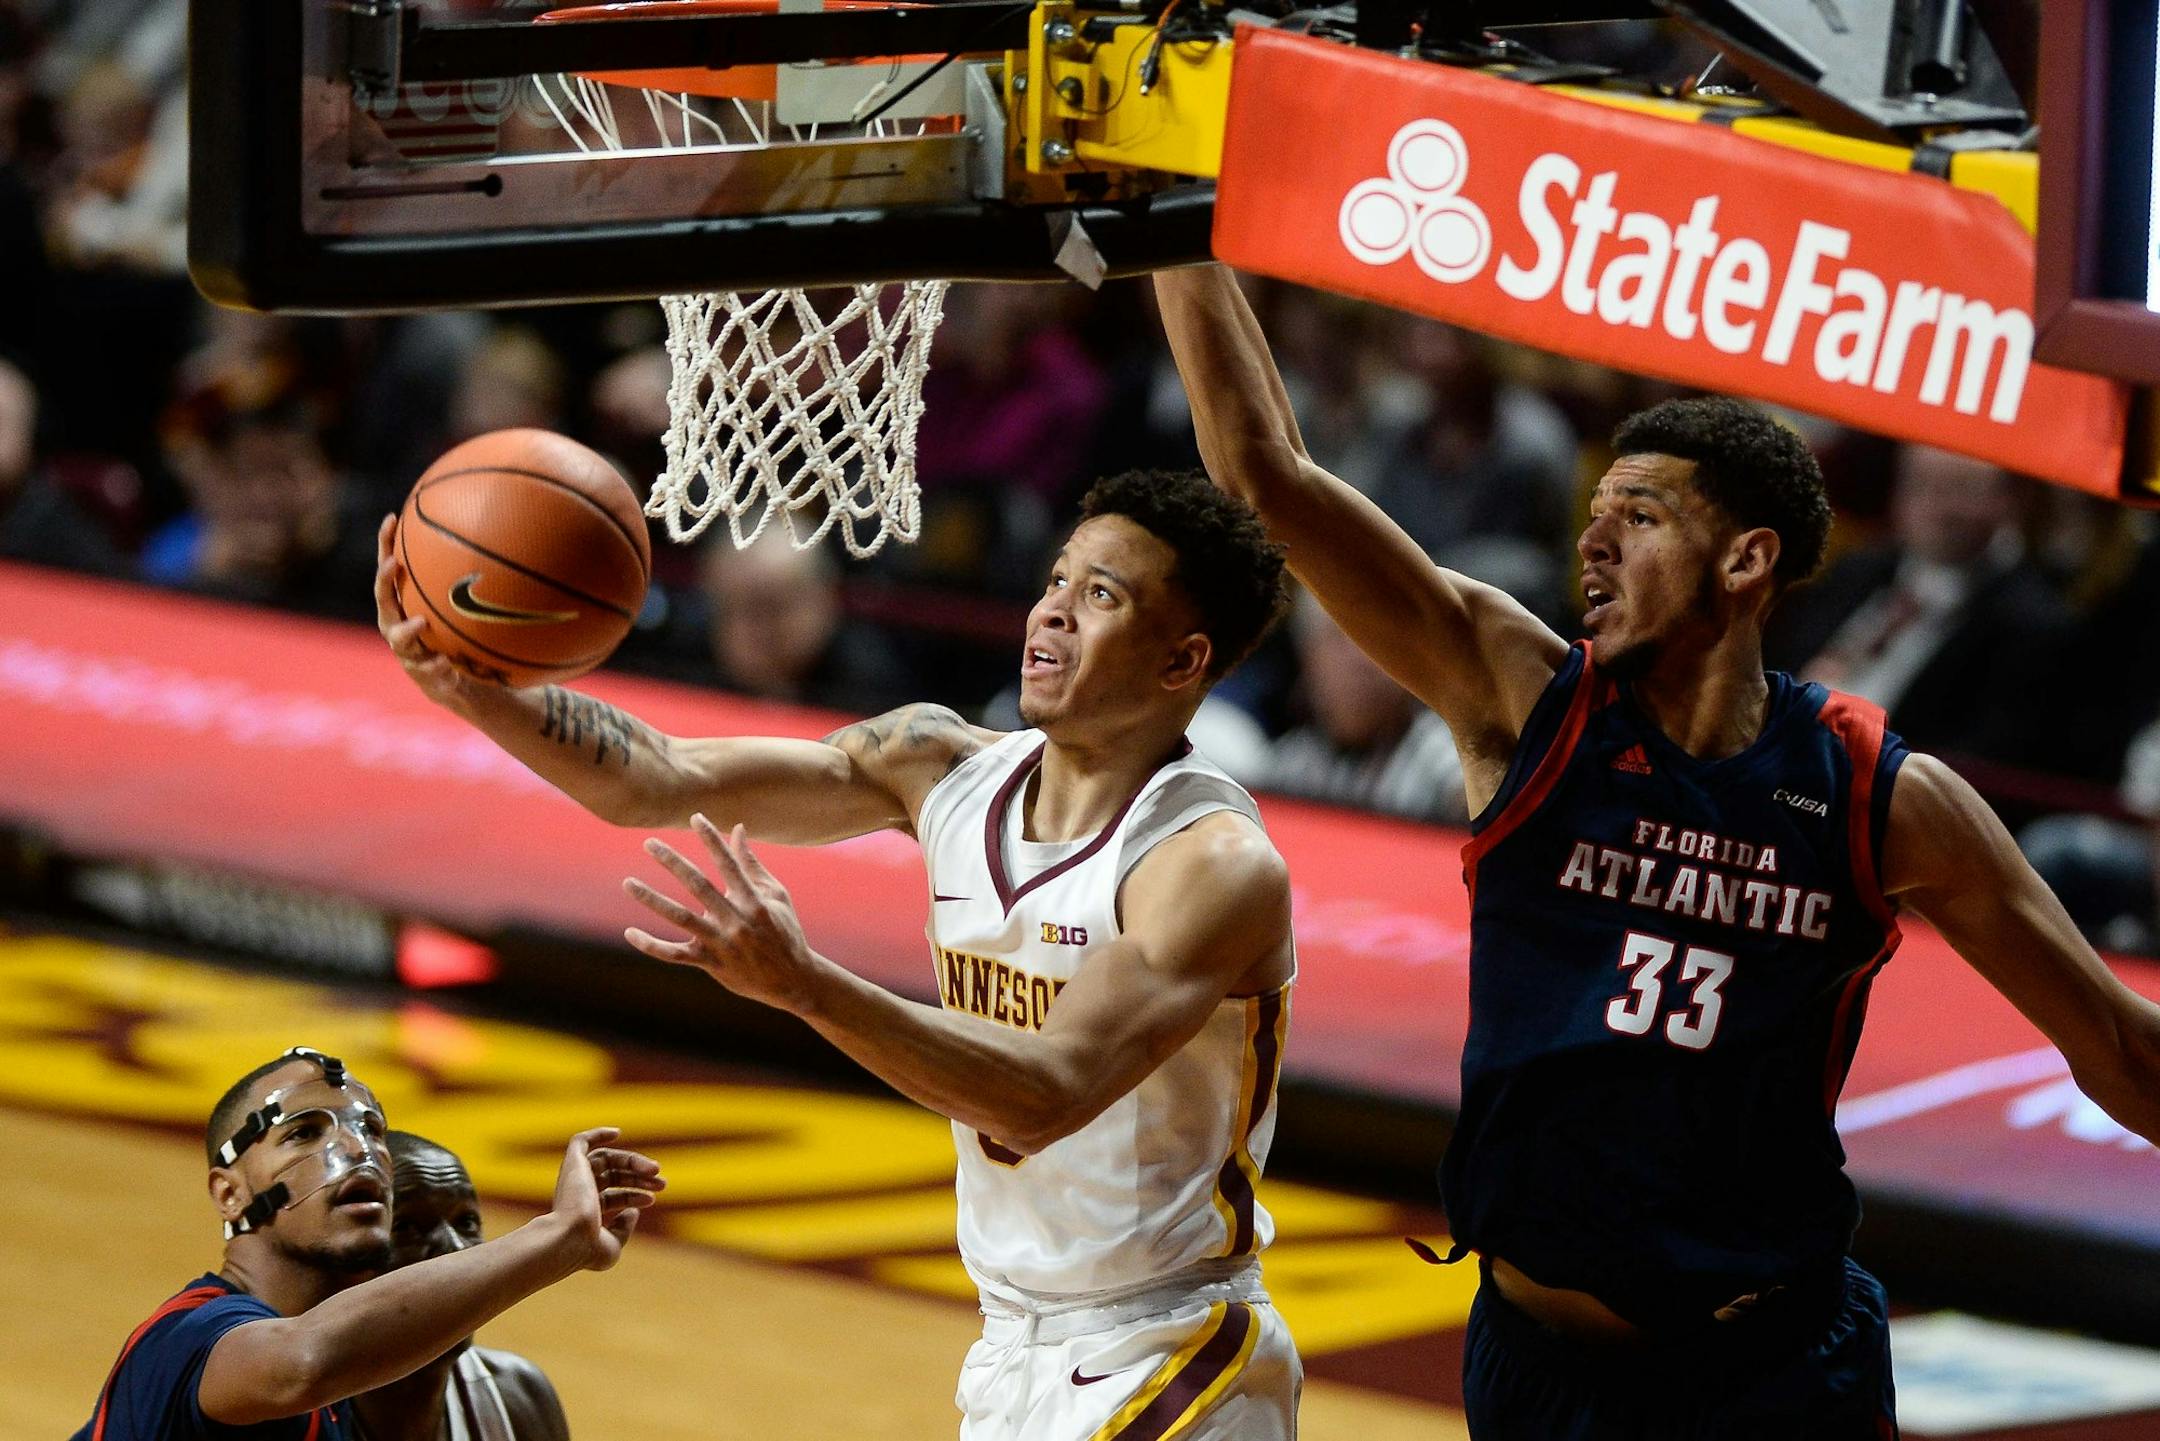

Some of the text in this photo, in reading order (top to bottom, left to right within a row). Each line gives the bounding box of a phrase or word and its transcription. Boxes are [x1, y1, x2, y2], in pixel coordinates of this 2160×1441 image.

[1558, 841, 1834, 941] ATLANTIC
[1634, 818, 1778, 873] FLORIDA
[938, 947, 1067, 1033] NNESO
[1605, 928, 1737, 1052] 33
